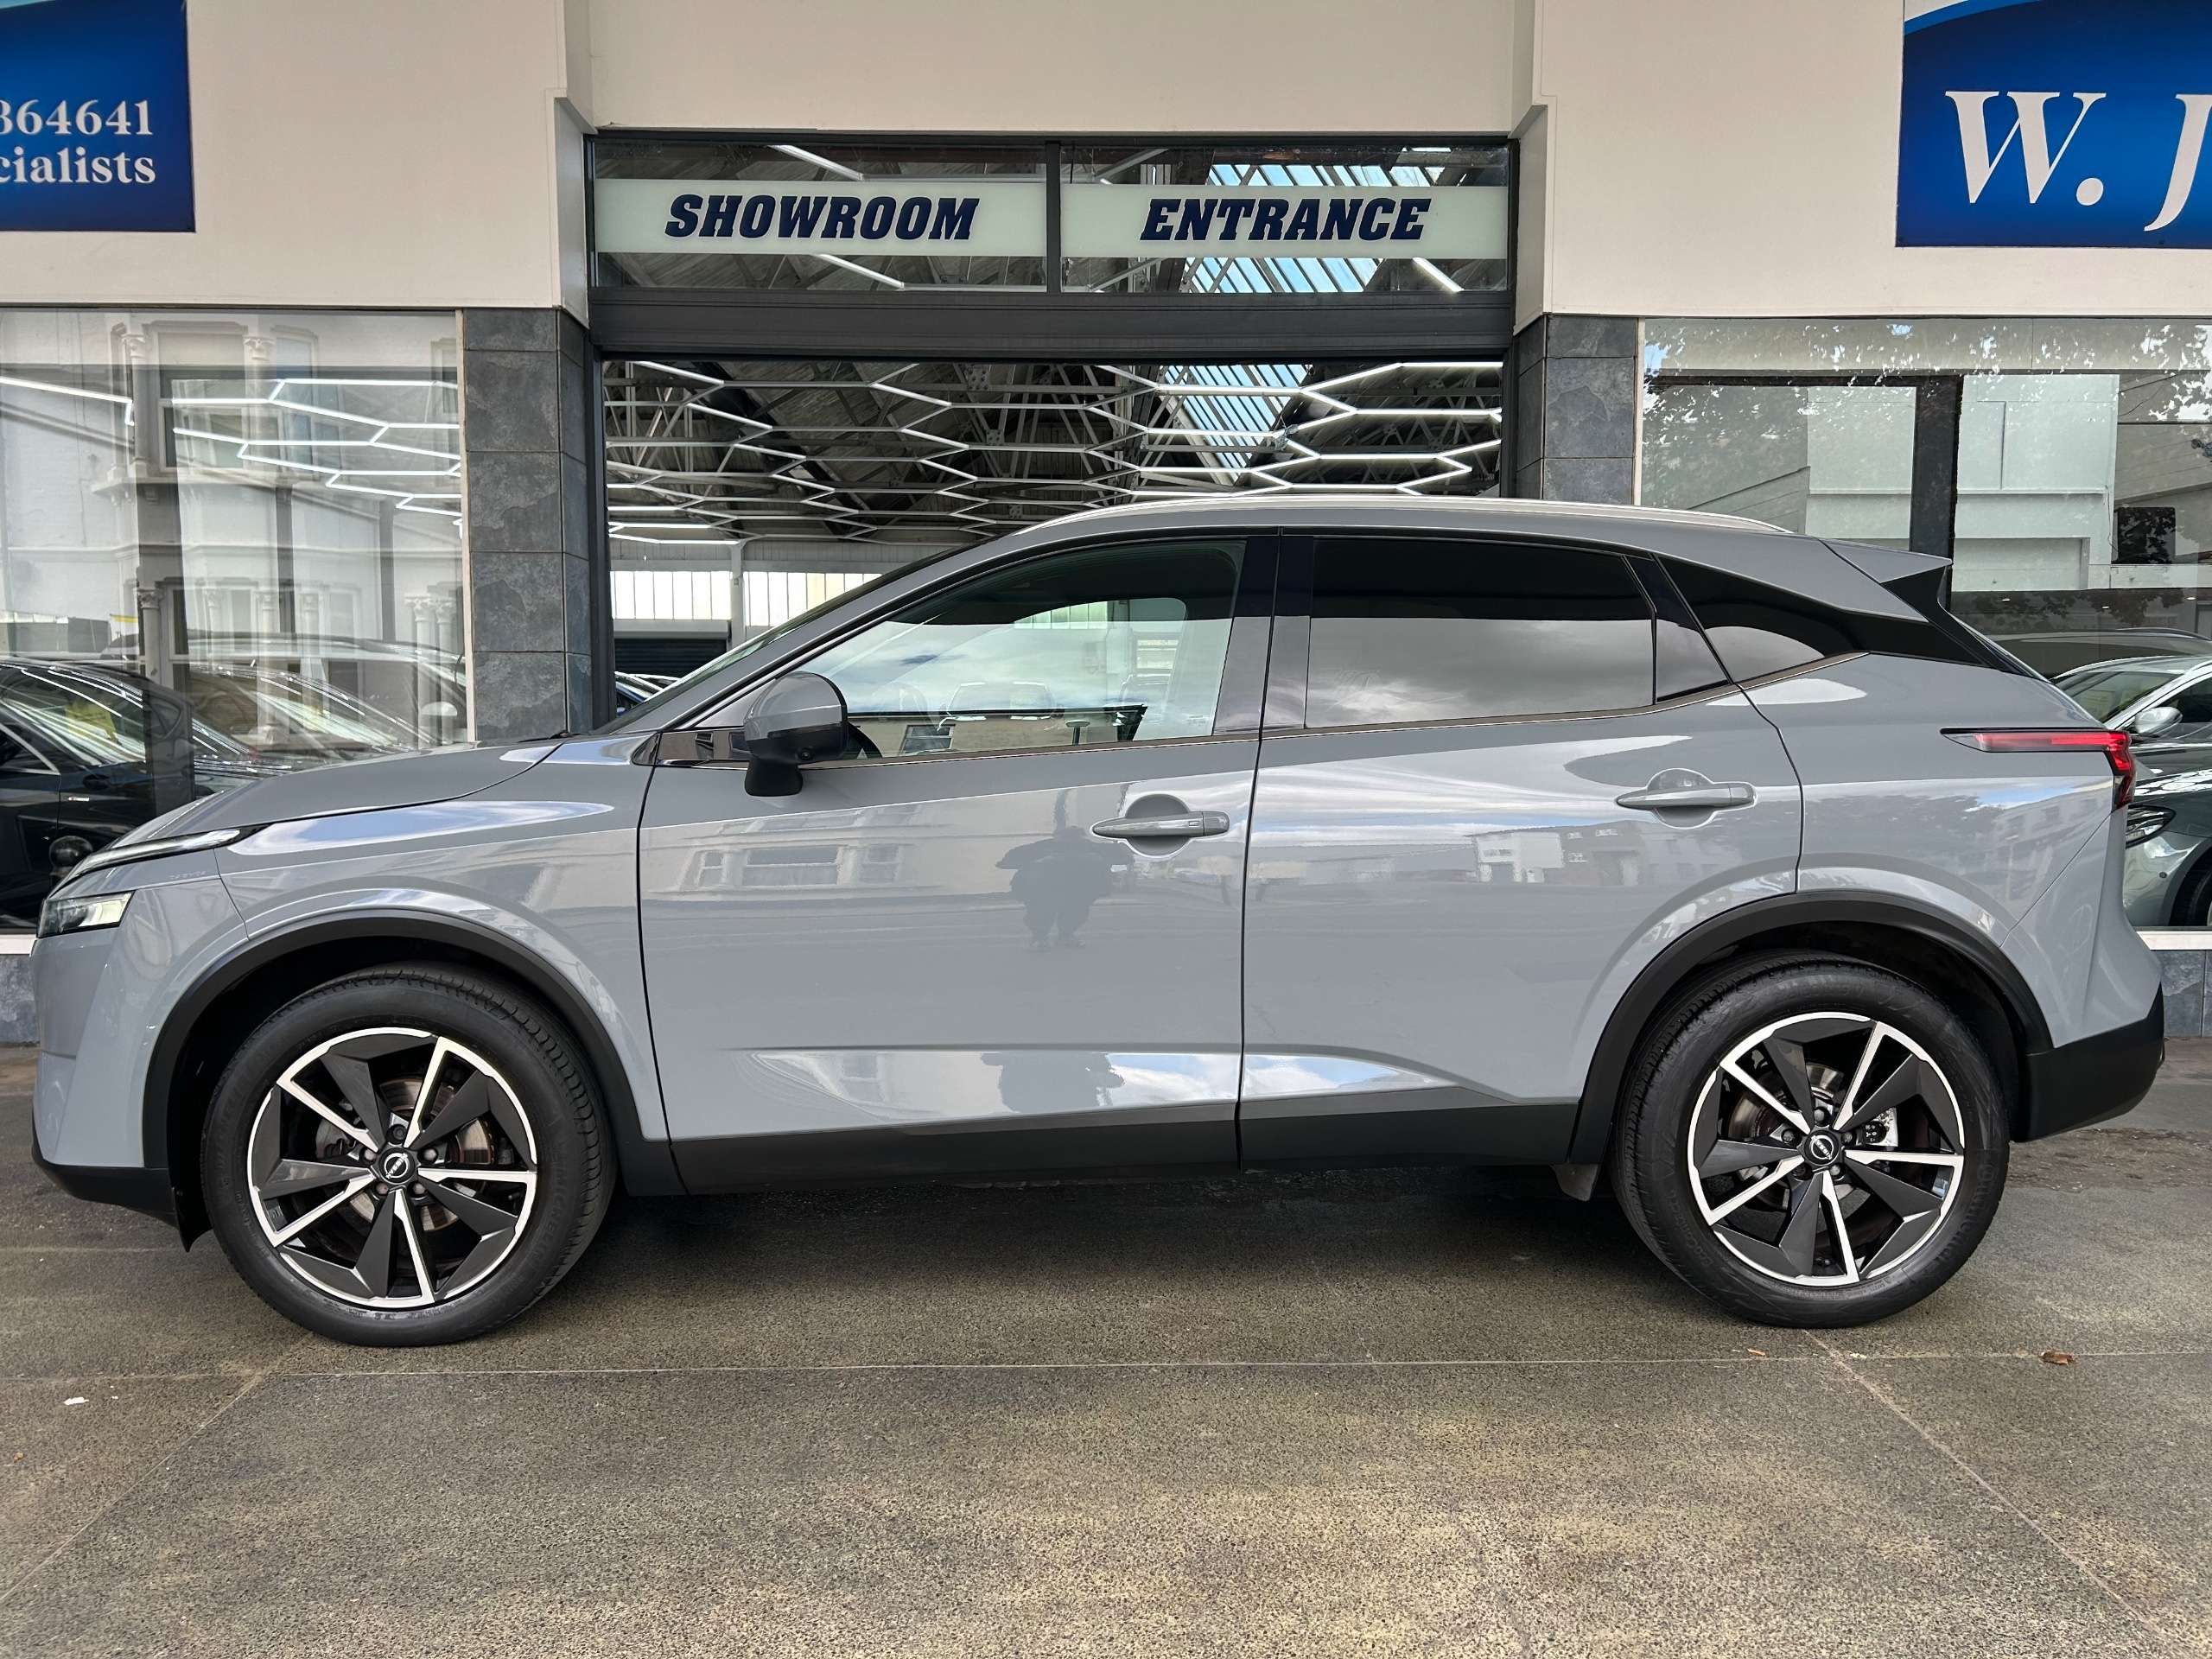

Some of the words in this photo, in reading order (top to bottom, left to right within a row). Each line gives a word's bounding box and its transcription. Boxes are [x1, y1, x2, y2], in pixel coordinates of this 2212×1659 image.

[1945, 91, 2107, 206] W.
[664, 194, 980, 240] SHOWROOM
[1140, 198, 1432, 241] ENTRANCE
